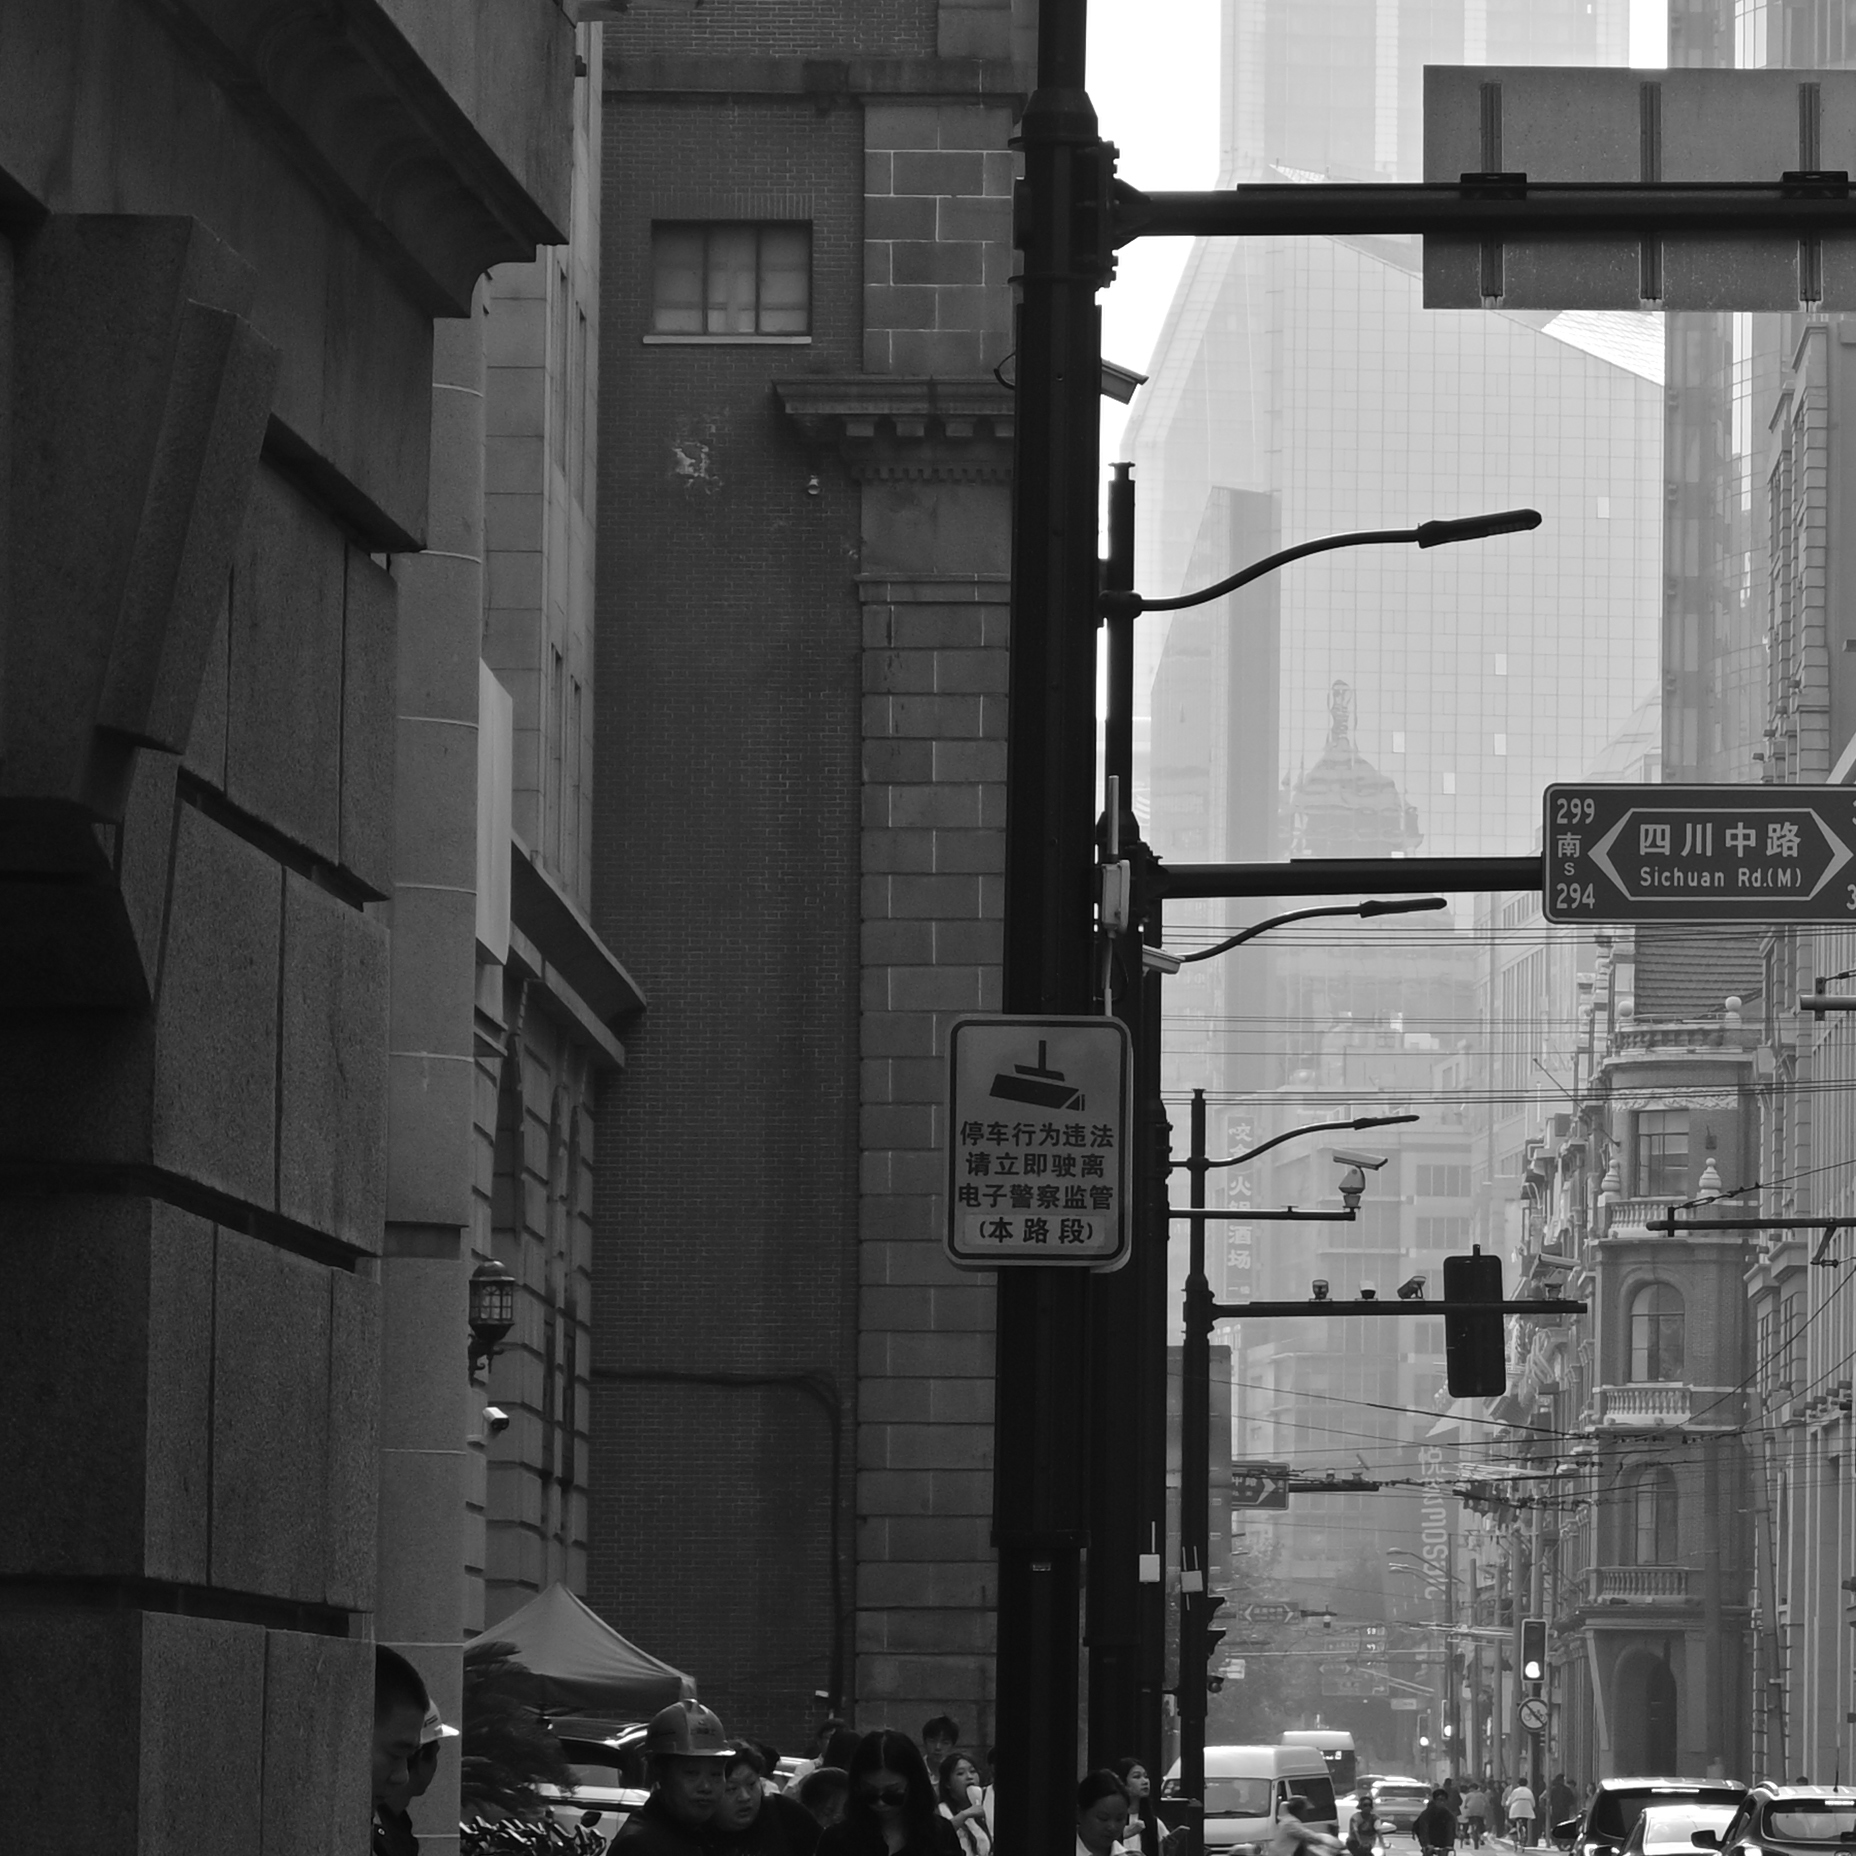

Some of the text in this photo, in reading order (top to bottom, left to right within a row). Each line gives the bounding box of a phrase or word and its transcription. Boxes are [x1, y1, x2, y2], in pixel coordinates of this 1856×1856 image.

[1556, 798, 1596, 825] 299
[1556, 832, 1582, 858] 南
[1639, 822, 1802, 858] 四川中路
[1564, 862, 1575, 876] S
[1640, 867, 1802, 889] Sichuan Rd.(M)
[1556, 883, 1596, 910] 294
[960, 1120, 1115, 1148] 停车行为违法
[966, 1151, 1105, 1178] 请立即驶离
[958, 1183, 1114, 1210] 电子警察监管
